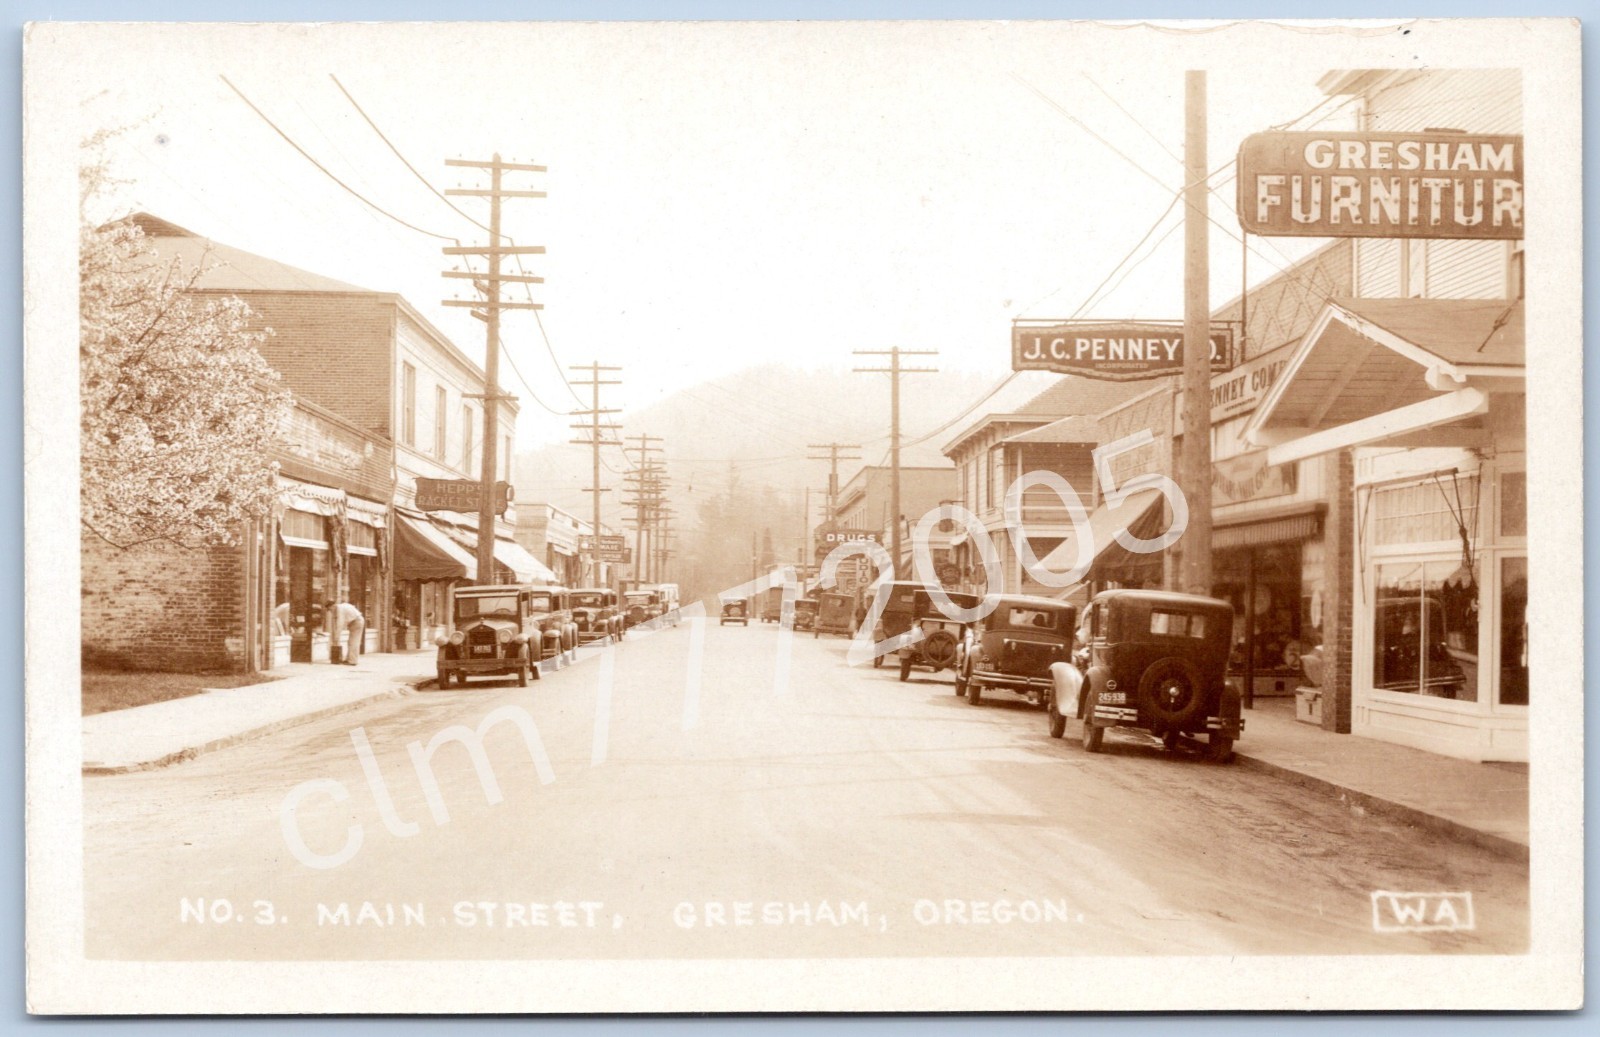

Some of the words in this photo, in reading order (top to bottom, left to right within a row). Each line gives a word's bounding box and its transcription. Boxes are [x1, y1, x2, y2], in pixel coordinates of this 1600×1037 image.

[1304, 139, 1515, 171] GRESHAM
[1256, 174, 1523, 227] FURNITUR
[1075, 337, 1181, 361] PENNEY
[825, 532, 877, 542] DRUGS
